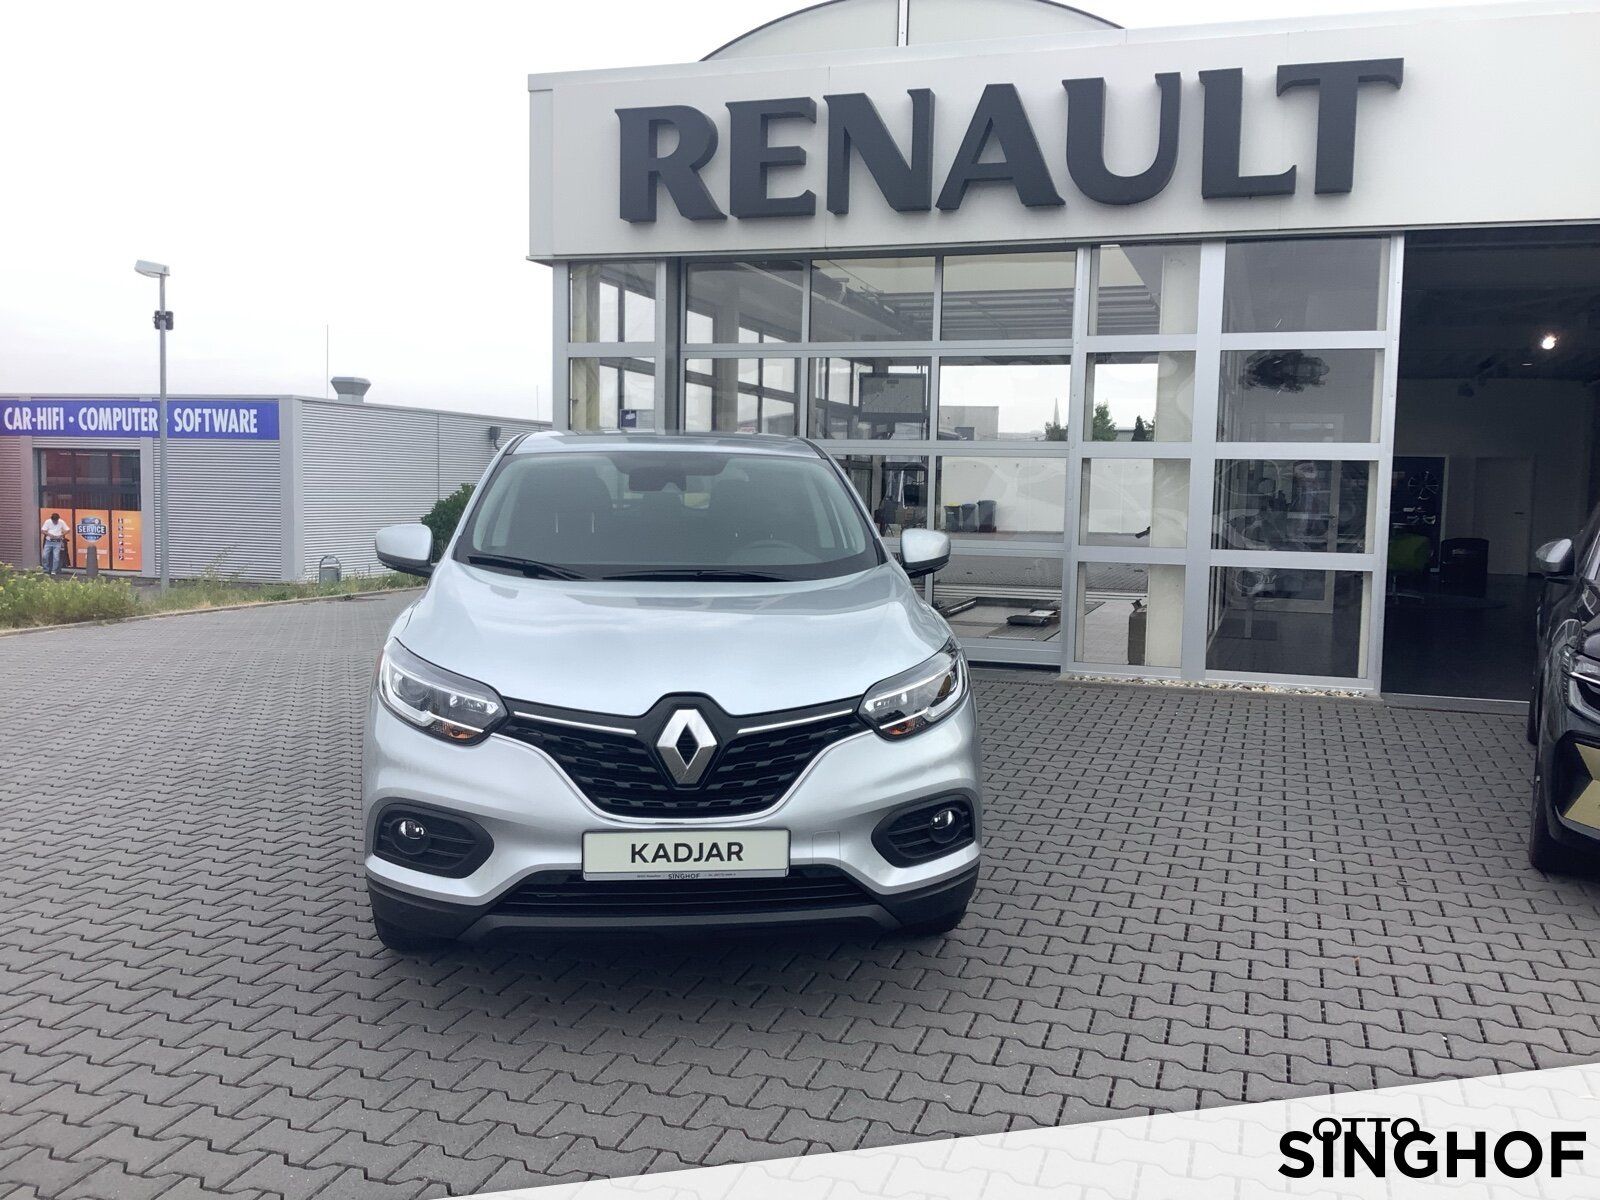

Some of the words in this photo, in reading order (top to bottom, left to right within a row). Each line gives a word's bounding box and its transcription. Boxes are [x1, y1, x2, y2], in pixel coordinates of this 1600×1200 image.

[615, 57, 1404, 223] RENAULT
[4, 407, 64, 431] CAR-HIFI
[78, 407, 159, 432] COMPUTER
[174, 408, 258, 433] SOFTWARE
[78, 525, 105, 533] SERVICE
[631, 842, 744, 863] KADJAR
